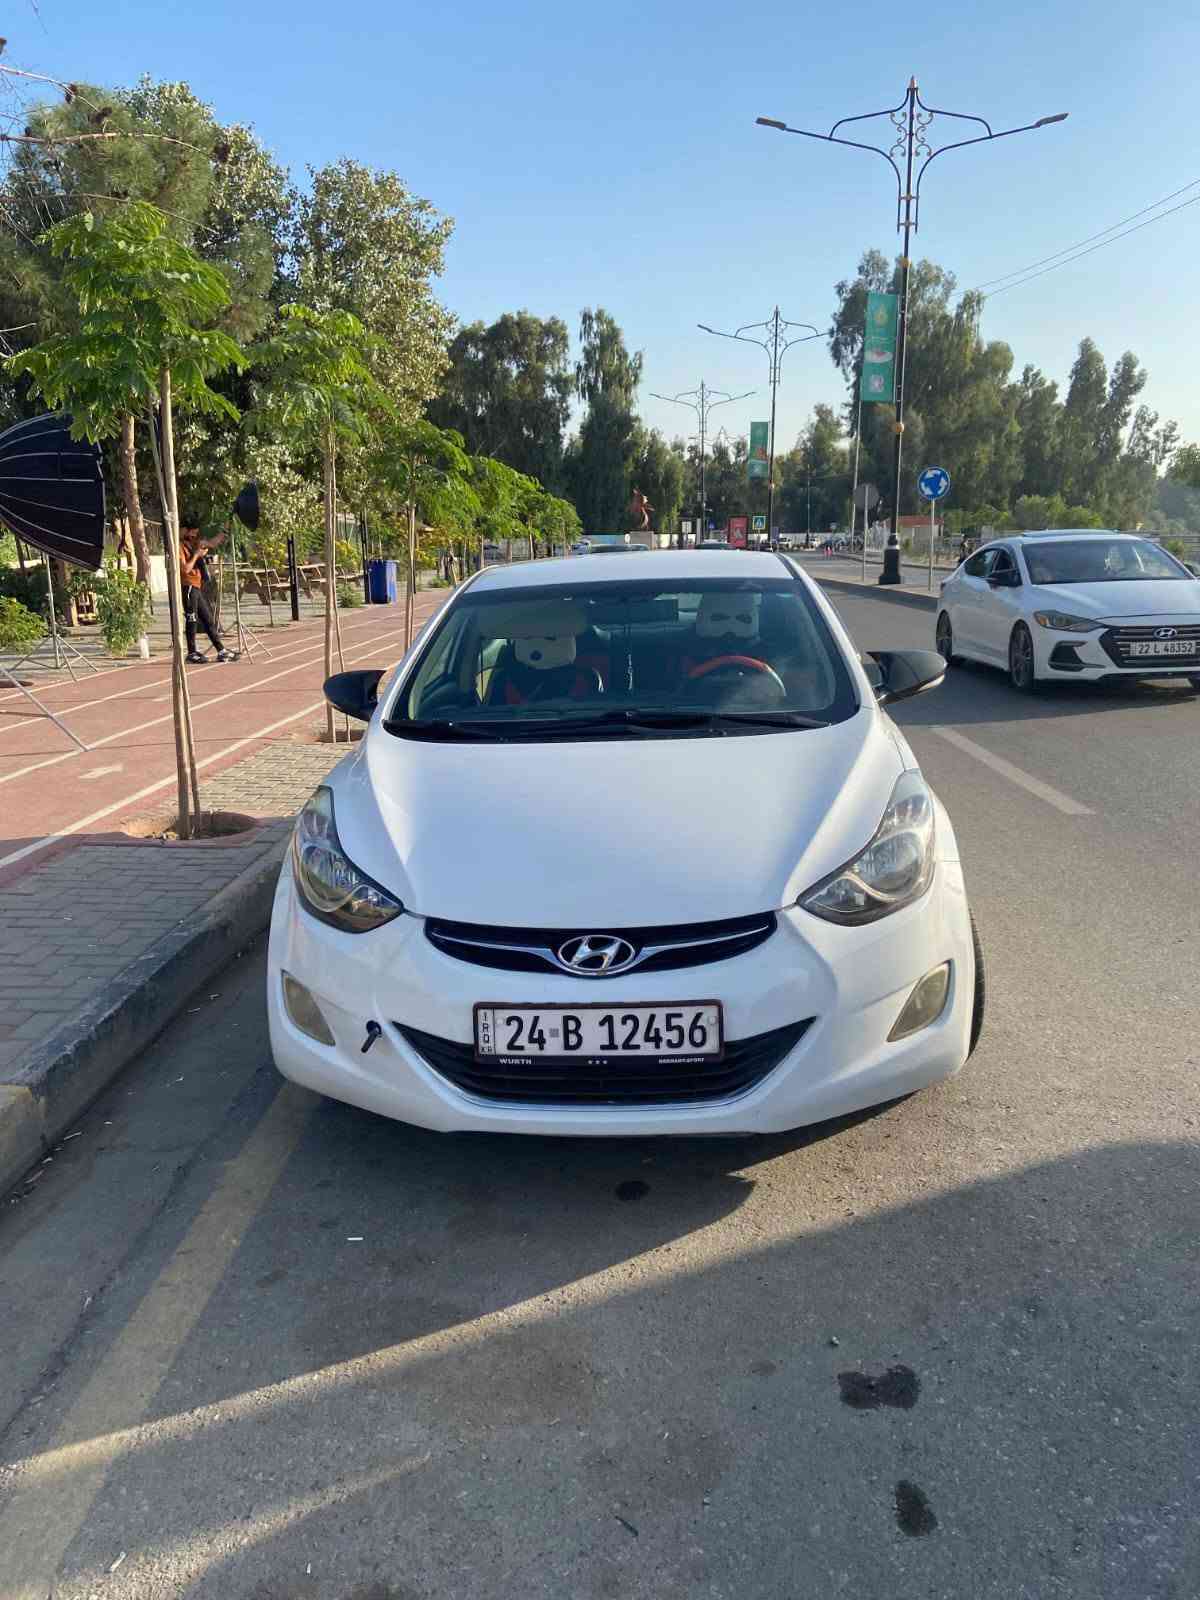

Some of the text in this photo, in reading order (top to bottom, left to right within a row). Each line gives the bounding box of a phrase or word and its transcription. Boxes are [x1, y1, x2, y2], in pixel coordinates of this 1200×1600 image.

[505, 1012, 707, 1051] 24 B 12456
